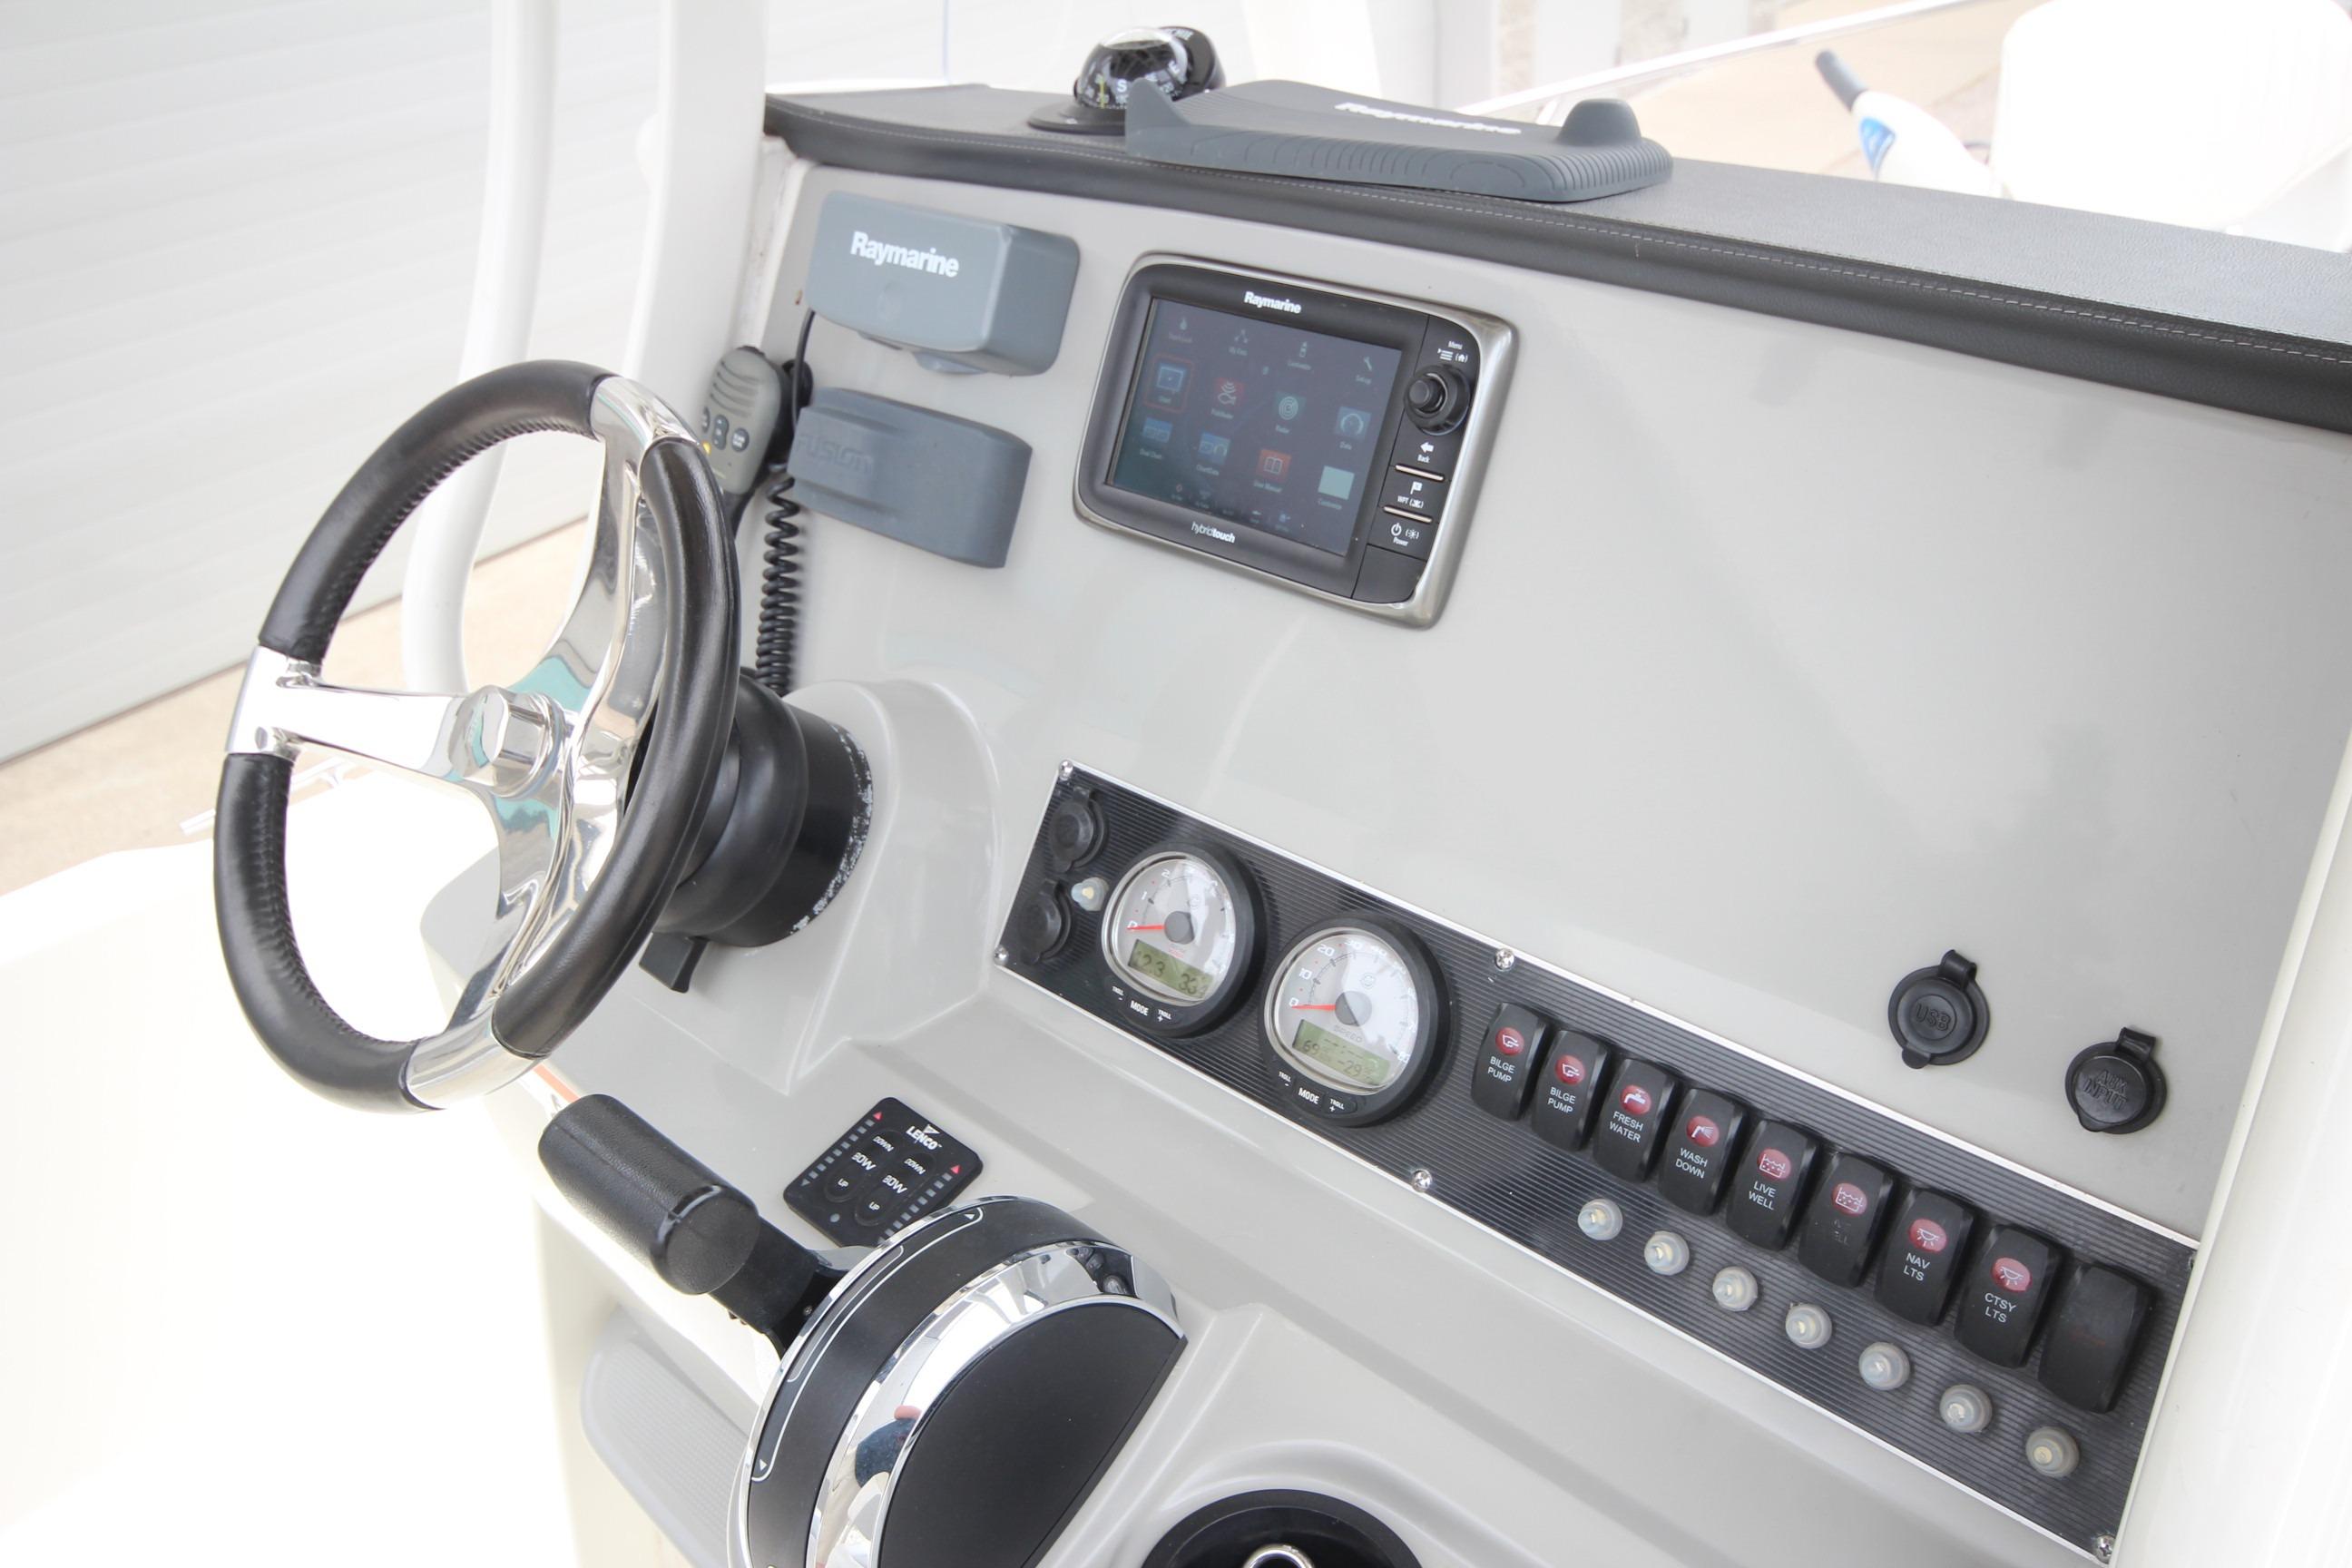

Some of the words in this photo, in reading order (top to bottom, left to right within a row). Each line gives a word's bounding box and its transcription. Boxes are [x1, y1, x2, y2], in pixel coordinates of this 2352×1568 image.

[850, 231, 959, 278] Raymarine
[1244, 290, 1302, 314] Raymarine
[1417, 454, 1430, 464] Back
[1393, 537, 1408, 547] Power
[1318, 944, 1335, 956] 20
[1299, 968, 1312, 980] 10
[1131, 1000, 1149, 1015] MODE
[1158, 1010, 1171, 1020] TROLL
[1916, 1004, 1951, 1031] USB
[1490, 1055, 1514, 1073] BILGE
[1279, 1071, 1292, 1082] TROLL
[1487, 1067, 1512, 1083] PUMP
[2096, 1070, 2127, 1093] AUX
[1298, 1087, 1319, 1104] MODE
[1550, 1086, 1577, 1105] BILGE
[2083, 1079, 2127, 1110] INPUT
[1330, 1098, 1344, 1110] TROLL
[1547, 1098, 1573, 1114] PUMP
[1613, 1112, 1643, 1131] FRESH
[906, 1125, 937, 1150] LENCO
[1610, 1122, 1641, 1142] WATER
[873, 1136, 894, 1152] DOWN
[852, 1152, 876, 1171] BOW
[1681, 1148, 1708, 1167] WASH
[904, 1158, 926, 1175] DOWN
[1675, 1158, 1705, 1178] DOWN
[838, 1178, 848, 1188] UP
[882, 1175, 907, 1194] BOW
[1754, 1181, 1776, 1198] LIVE
[869, 1201, 880, 1210] UP
[1749, 1191, 1774, 1210] WELL
[1906, 1252, 1931, 1269] NAV
[1904, 1265, 1925, 1281] LTS
[1984, 1293, 2016, 1312] CTSY
[1985, 1307, 2006, 1323] LTS
